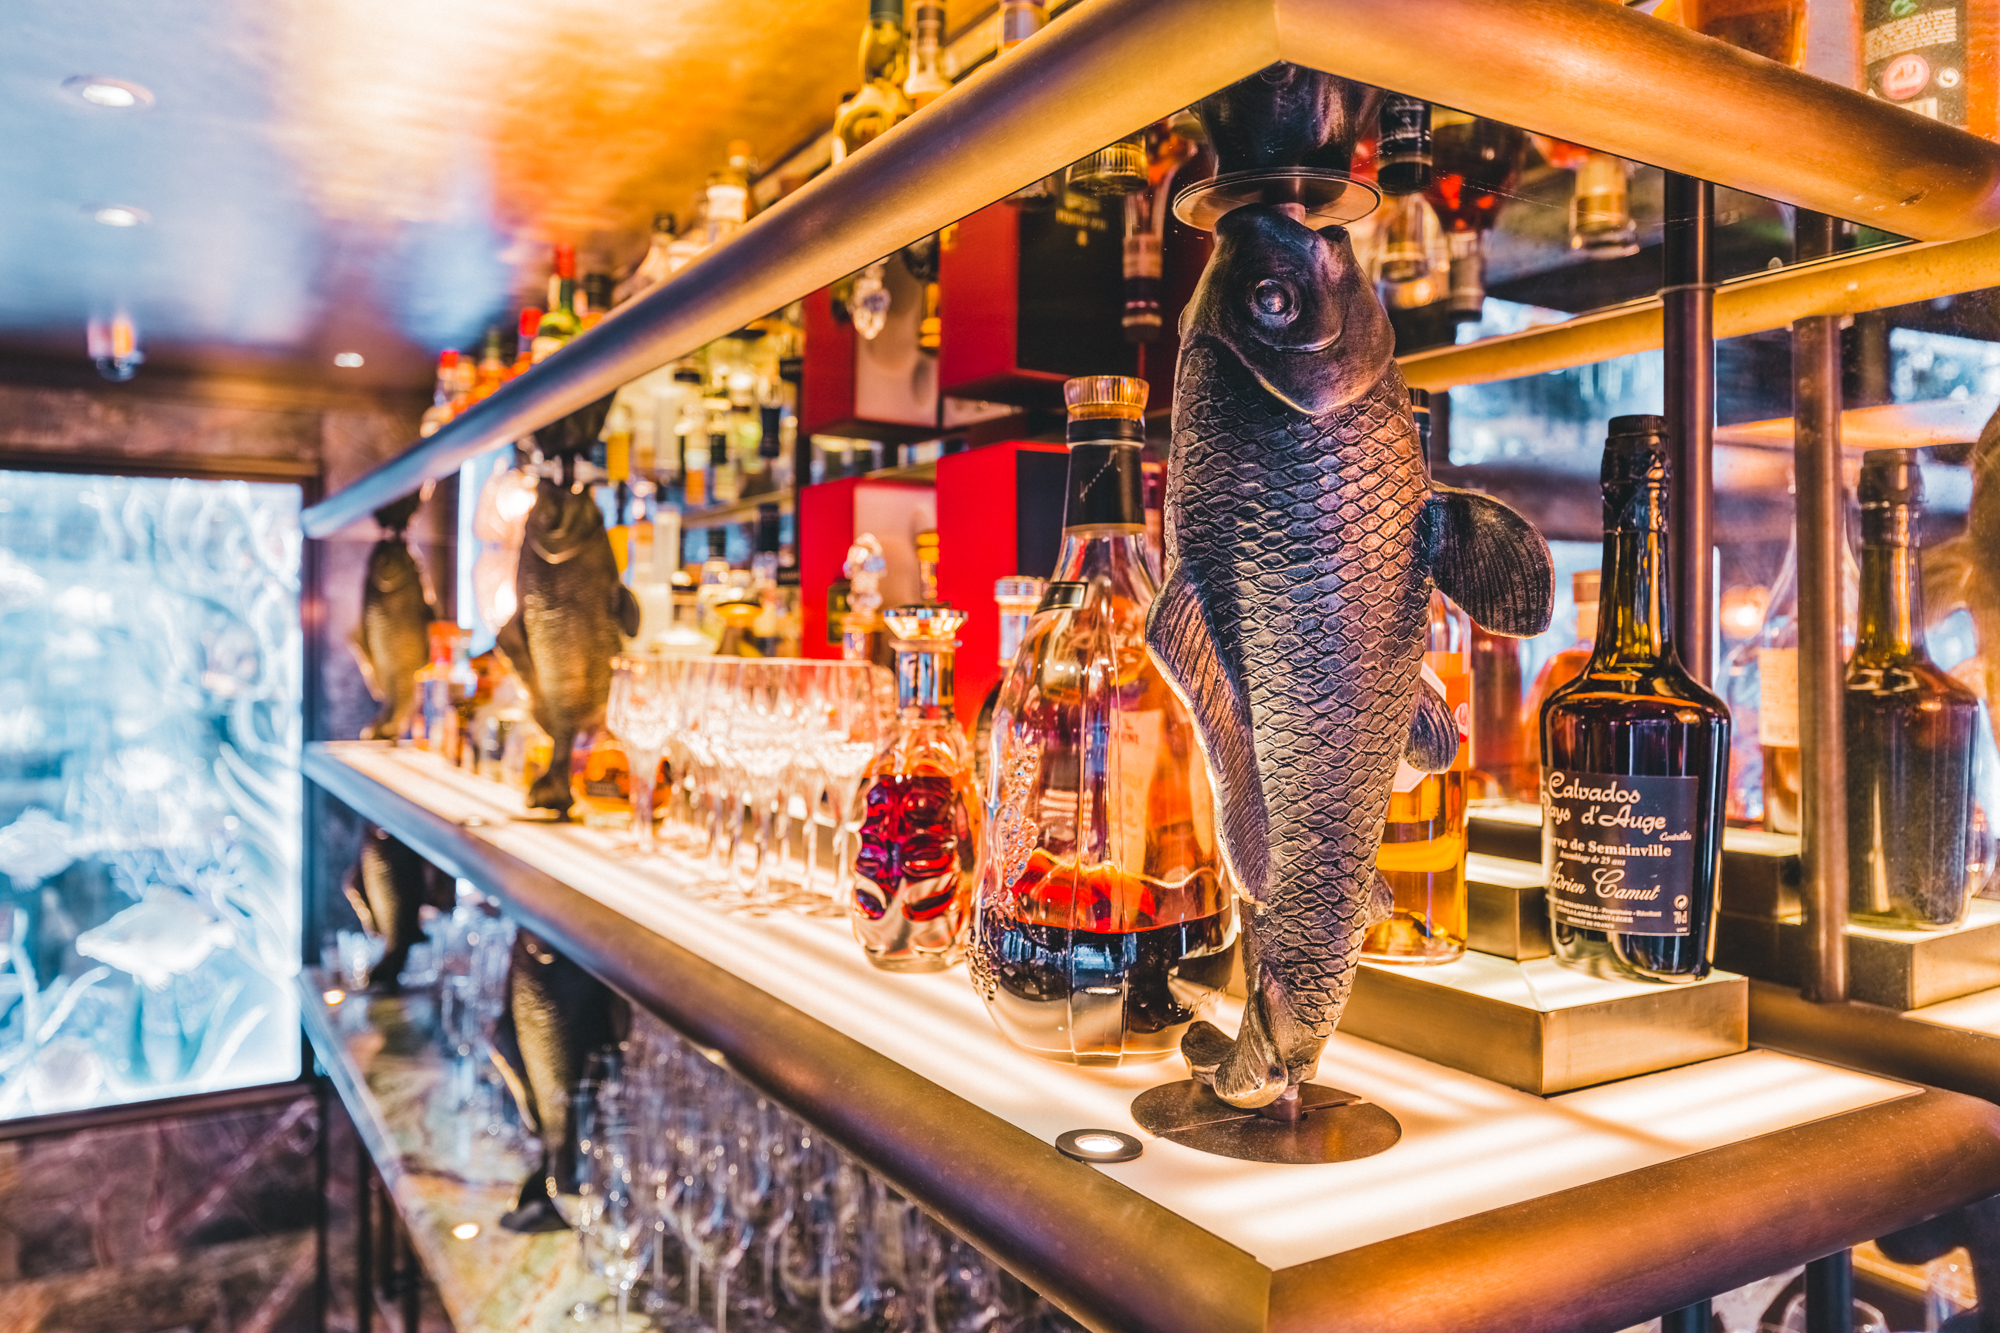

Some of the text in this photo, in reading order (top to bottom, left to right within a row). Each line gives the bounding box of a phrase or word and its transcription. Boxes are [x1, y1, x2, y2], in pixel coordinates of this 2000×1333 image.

[1549, 771, 1641, 804] Calvados
[1581, 804, 1666, 835] d'Auge
[1570, 838, 1585, 852] de
[1588, 840, 1672, 857] Semainville
[1591, 868, 1661, 900] Camut
